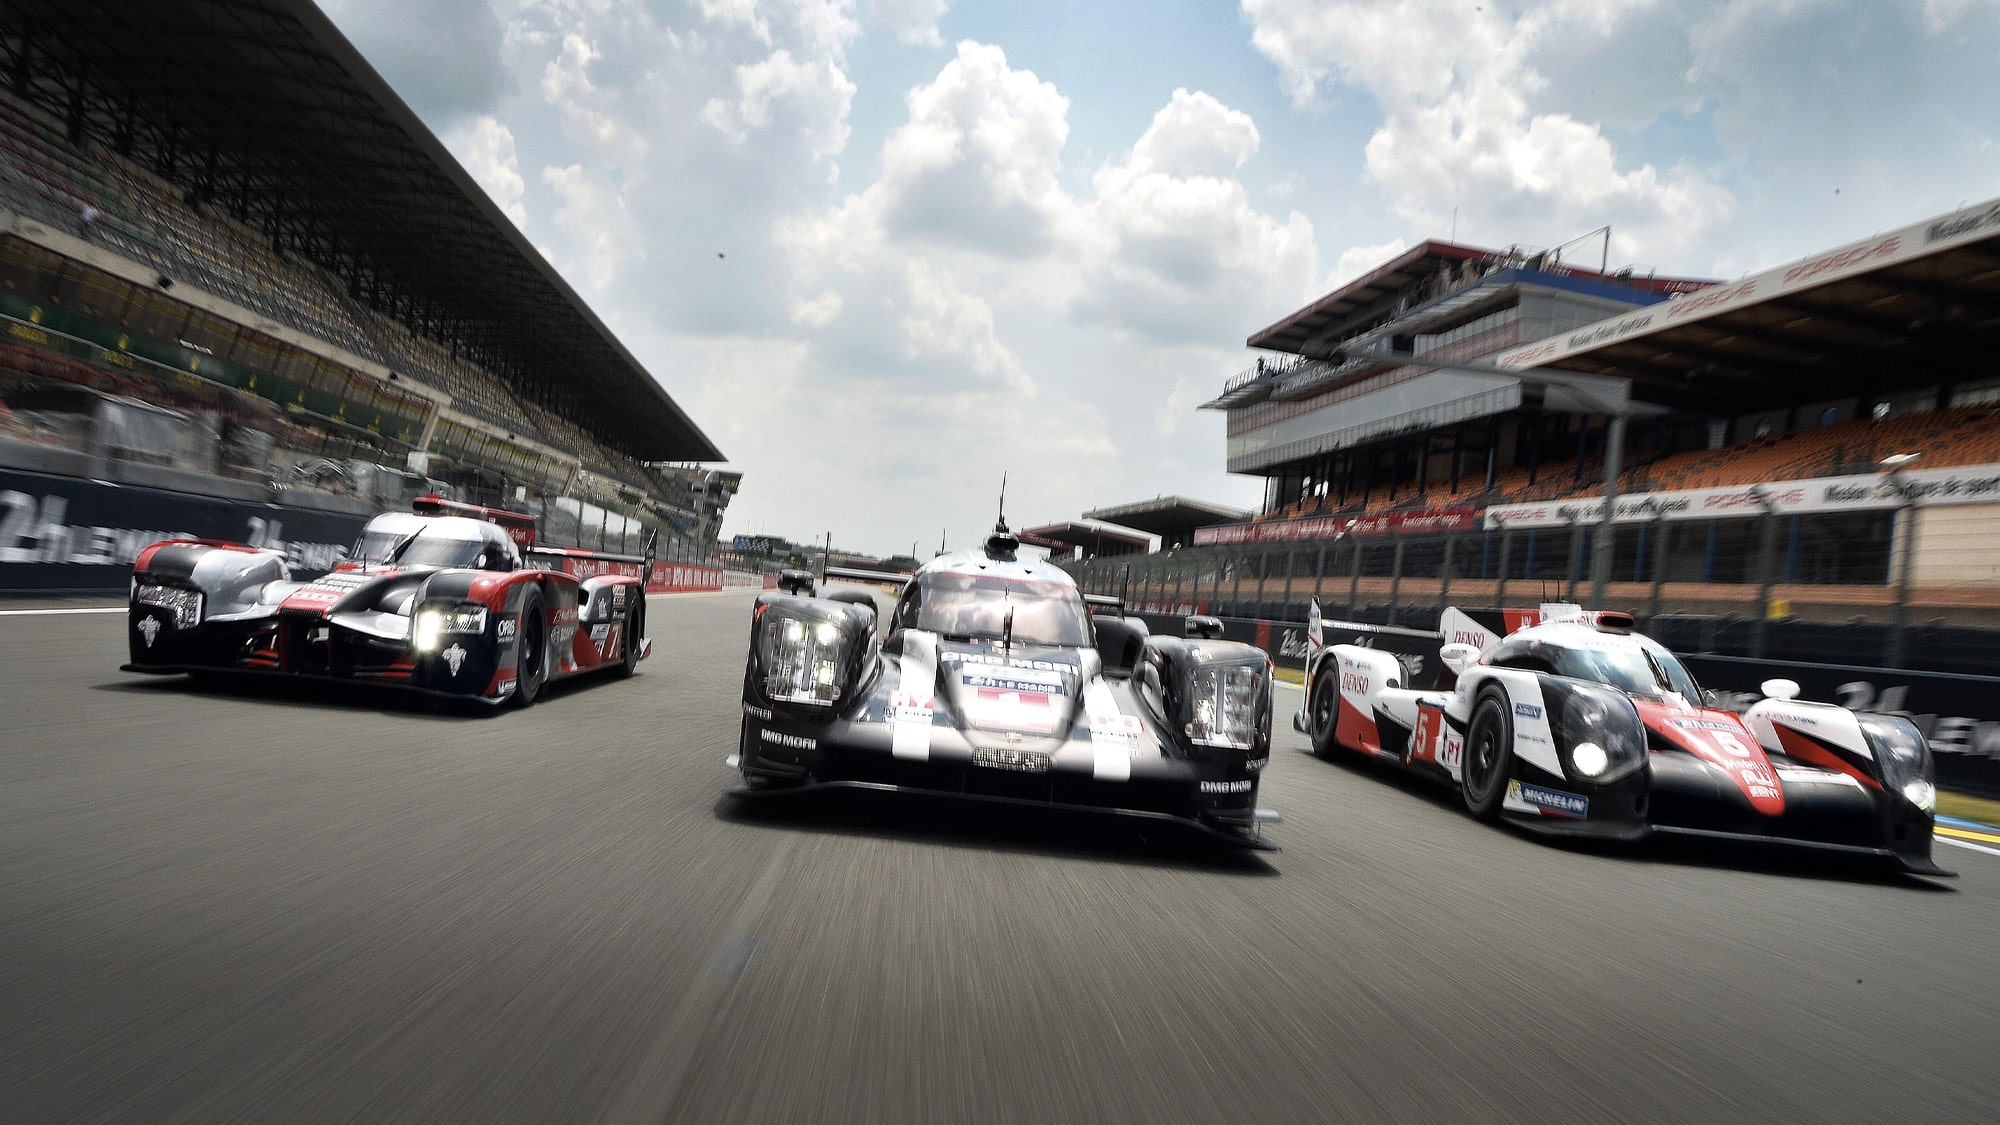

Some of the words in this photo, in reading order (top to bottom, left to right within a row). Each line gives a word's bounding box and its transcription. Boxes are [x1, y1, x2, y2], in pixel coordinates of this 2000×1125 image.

[1453, 630, 1485, 649] DENSO
[1341, 672, 1370, 695] DENSO
[761, 728, 783, 745] DMG
[782, 733, 817, 751] MORI
[1416, 712, 1429, 756] 5
[1711, 730, 1751, 759] 5
[1447, 740, 1460, 765] P1
[1201, 780, 1230, 794] DMG
[1524, 786, 1586, 813] MICHELIN
